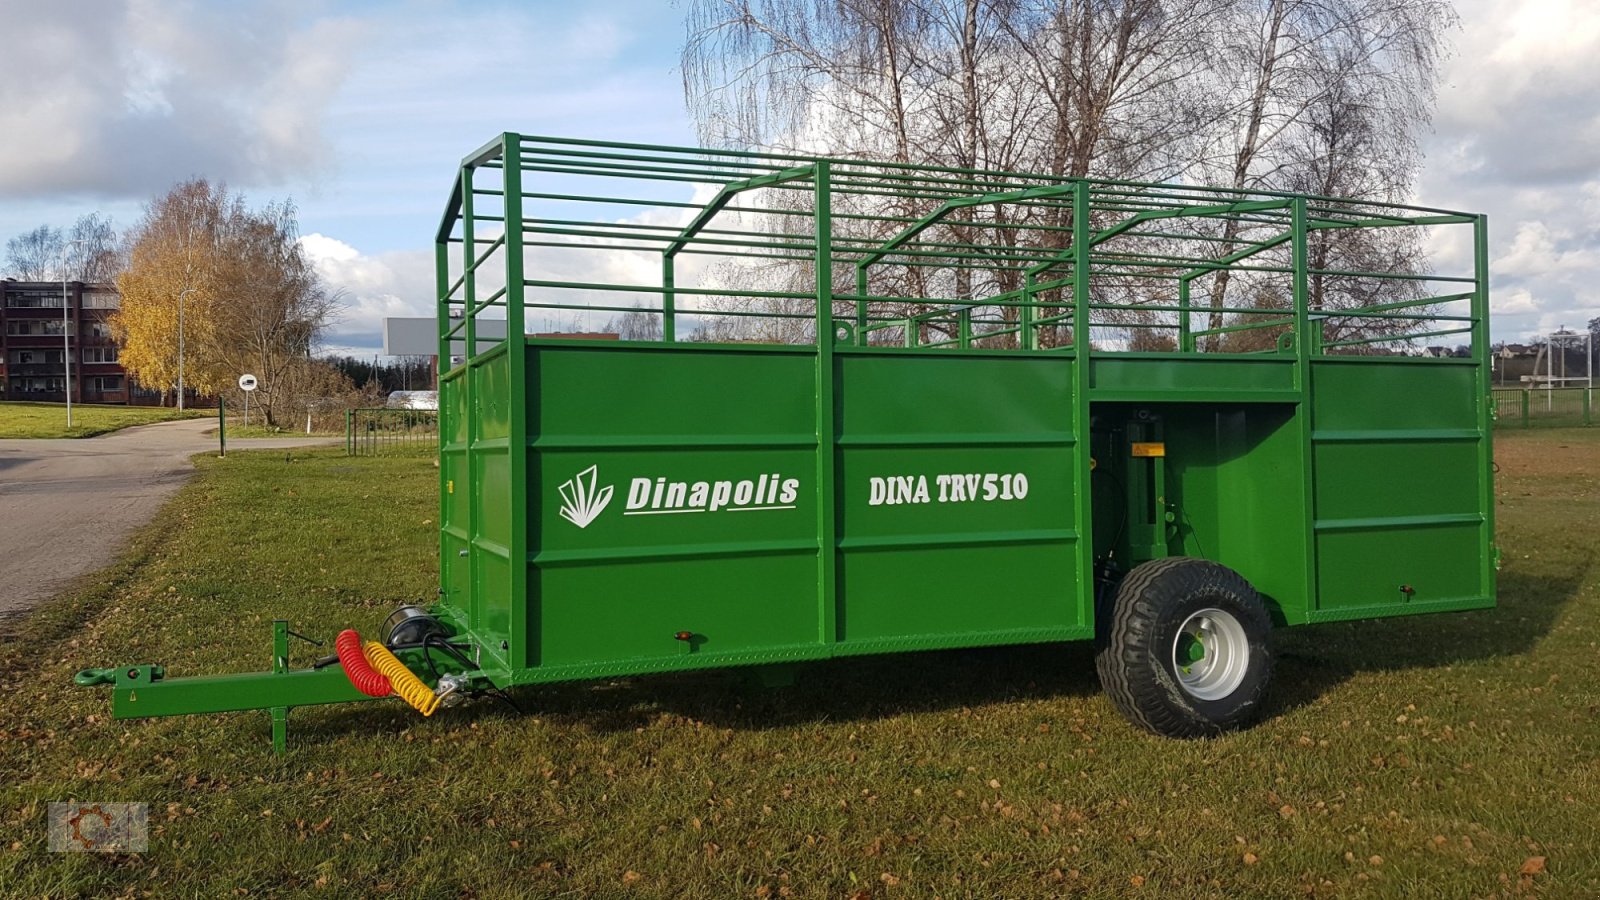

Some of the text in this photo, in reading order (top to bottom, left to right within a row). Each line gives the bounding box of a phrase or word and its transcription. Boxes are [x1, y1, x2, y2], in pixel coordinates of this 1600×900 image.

[625, 474, 800, 512] Dinapolis
[868, 472, 1029, 506] DINA TRV510
